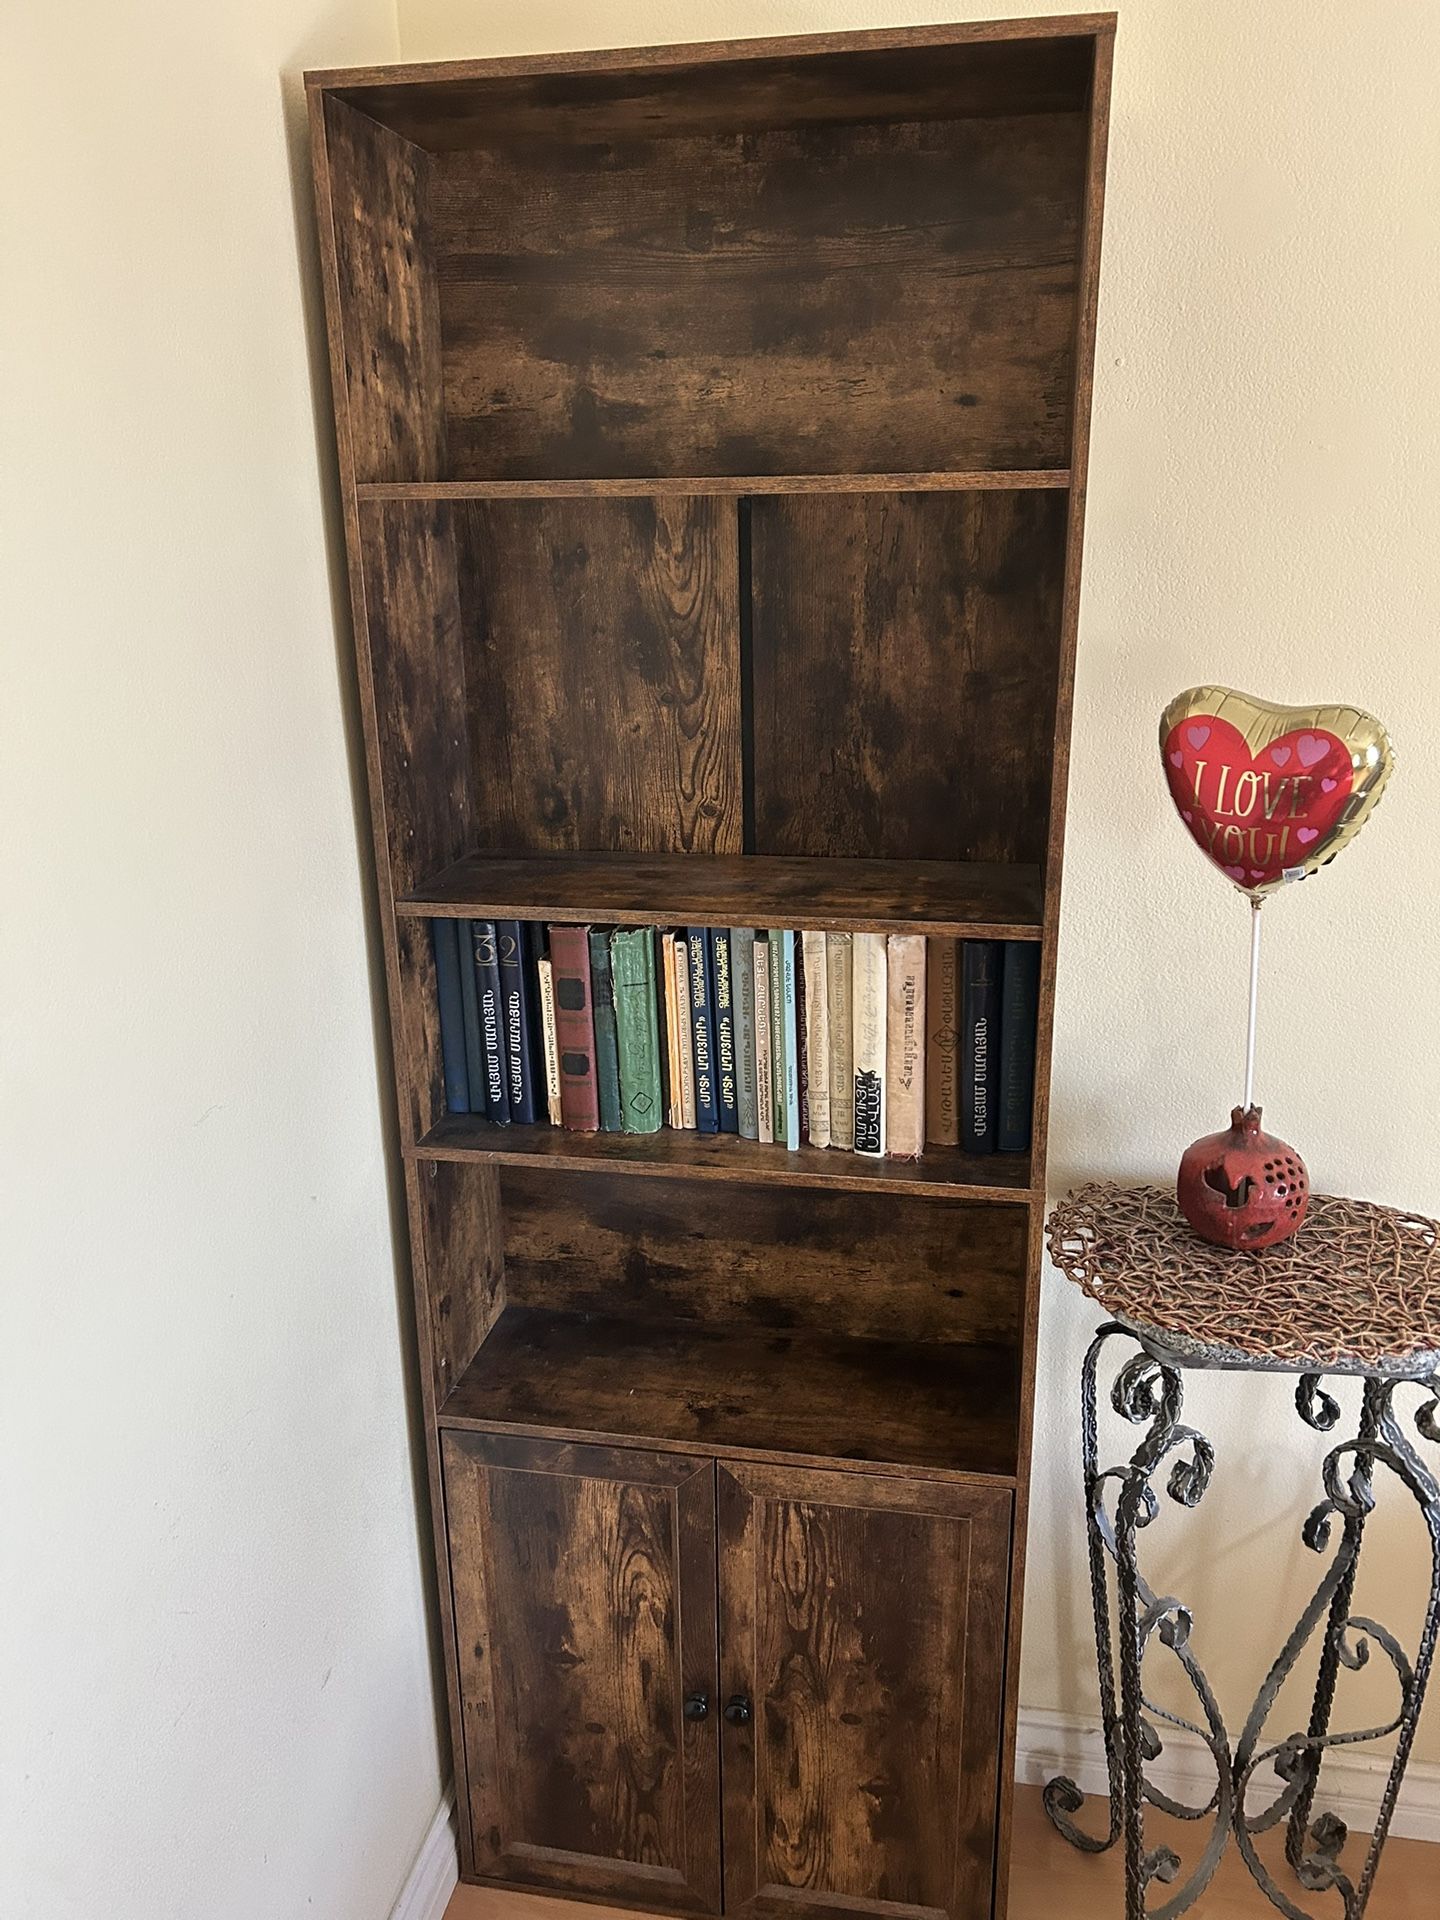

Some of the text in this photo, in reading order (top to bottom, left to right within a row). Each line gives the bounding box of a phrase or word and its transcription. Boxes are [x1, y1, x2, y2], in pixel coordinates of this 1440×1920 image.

[1192, 761, 1312, 820] I LOVE
[1200, 819, 1290, 866] YOU!
[500, 935, 519, 964] 2
[482, 990, 502, 1102] ՎԻԼՅԱՄ ՍԱՐՈՅԱՆ
[507, 991, 523, 1104] ՎԻԼՅԱՄ ՍԱՐՈՅԱՆ
[681, 1017, 689, 1051] SPIRITUAL
[684, 1075, 692, 1104] SUCCESS
[974, 1017, 988, 1137] ՎԻԼՅԱՄ ՍԱՐՈՅԱՆ
